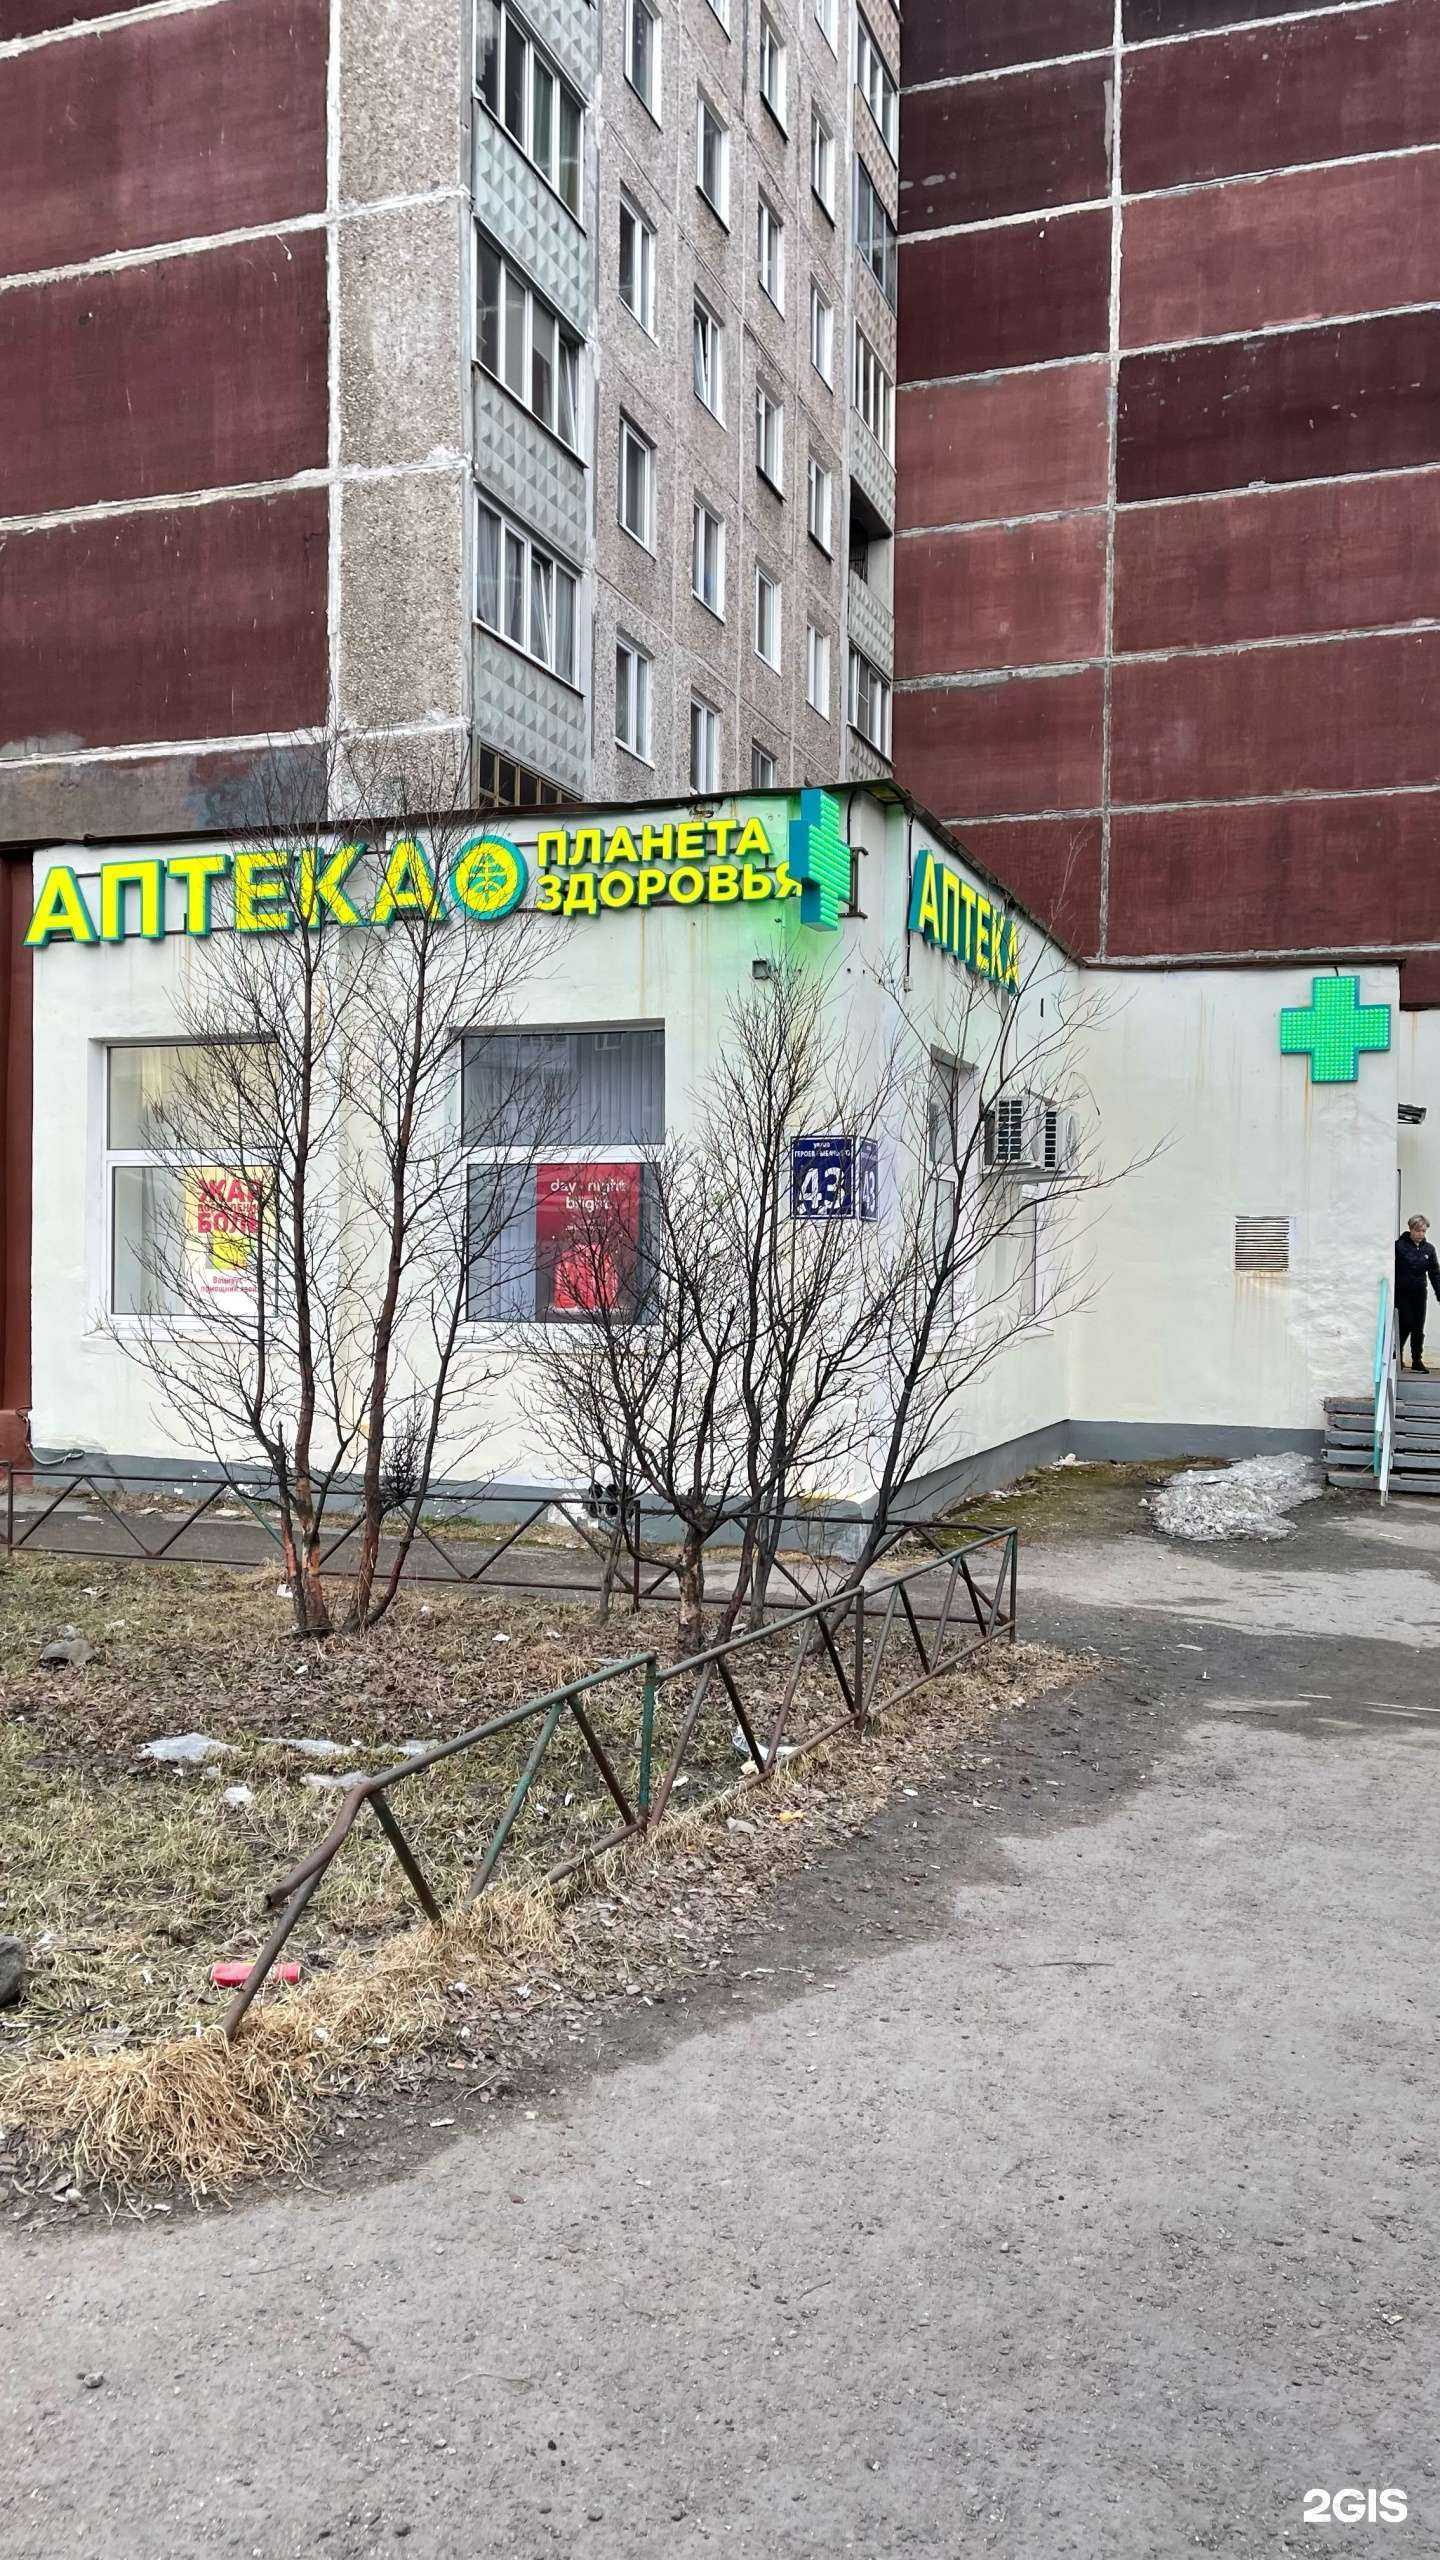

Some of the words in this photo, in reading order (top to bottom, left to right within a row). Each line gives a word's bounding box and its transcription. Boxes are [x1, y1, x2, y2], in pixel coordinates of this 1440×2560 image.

[537, 816, 772, 868] ПЛАНЕТА
[24, 837, 447, 947] АПТЕКА
[536, 862, 802, 917] ЗДОРОВЬЯ
[909, 850, 1021, 995] АПТЕКА
[550, 1179, 577, 1196] day
[587, 1178, 627, 1196] night
[565, 1196, 612, 1213] bright
[799, 1167, 846, 1209] 43
[862, 1171, 876, 1212] 43
